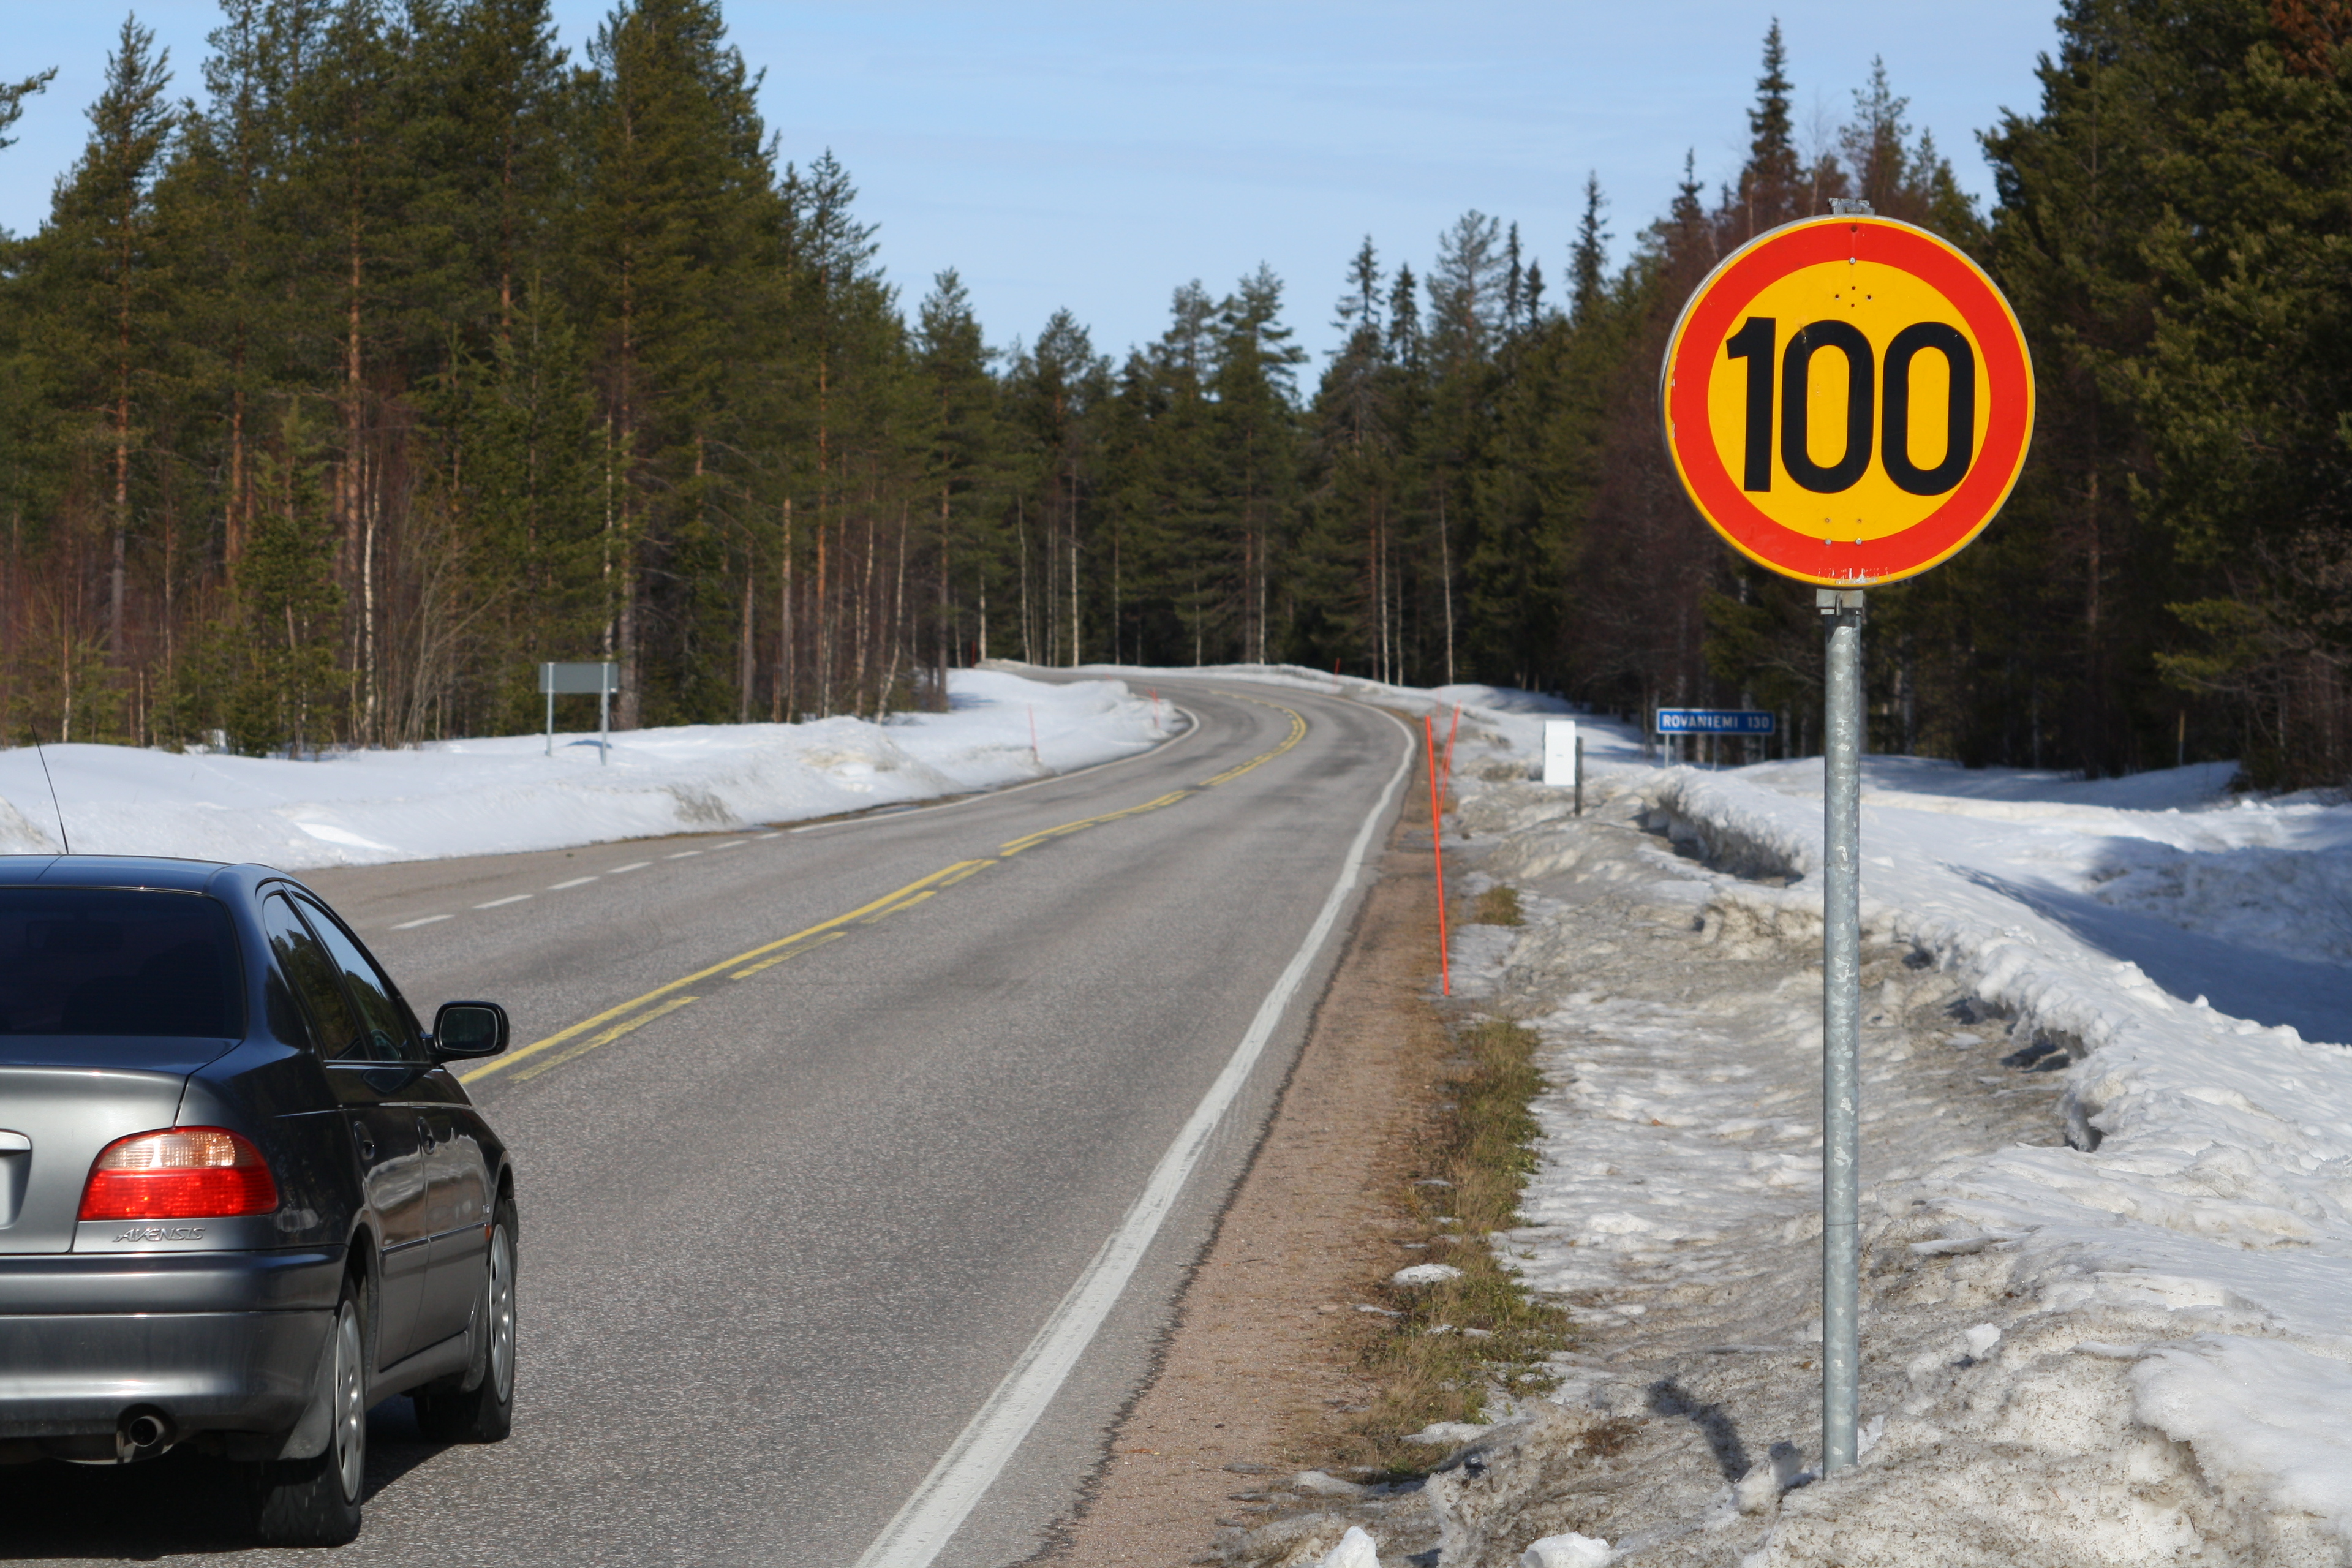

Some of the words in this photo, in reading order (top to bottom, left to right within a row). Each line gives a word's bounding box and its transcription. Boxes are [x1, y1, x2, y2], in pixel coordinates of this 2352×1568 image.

[1725, 317, 1975, 496] 100
[1662, 714, 1738, 728] ROVANIEMI
[1748, 717, 1769, 728] 130
[111, 1227, 205, 1243] AVENSIS
